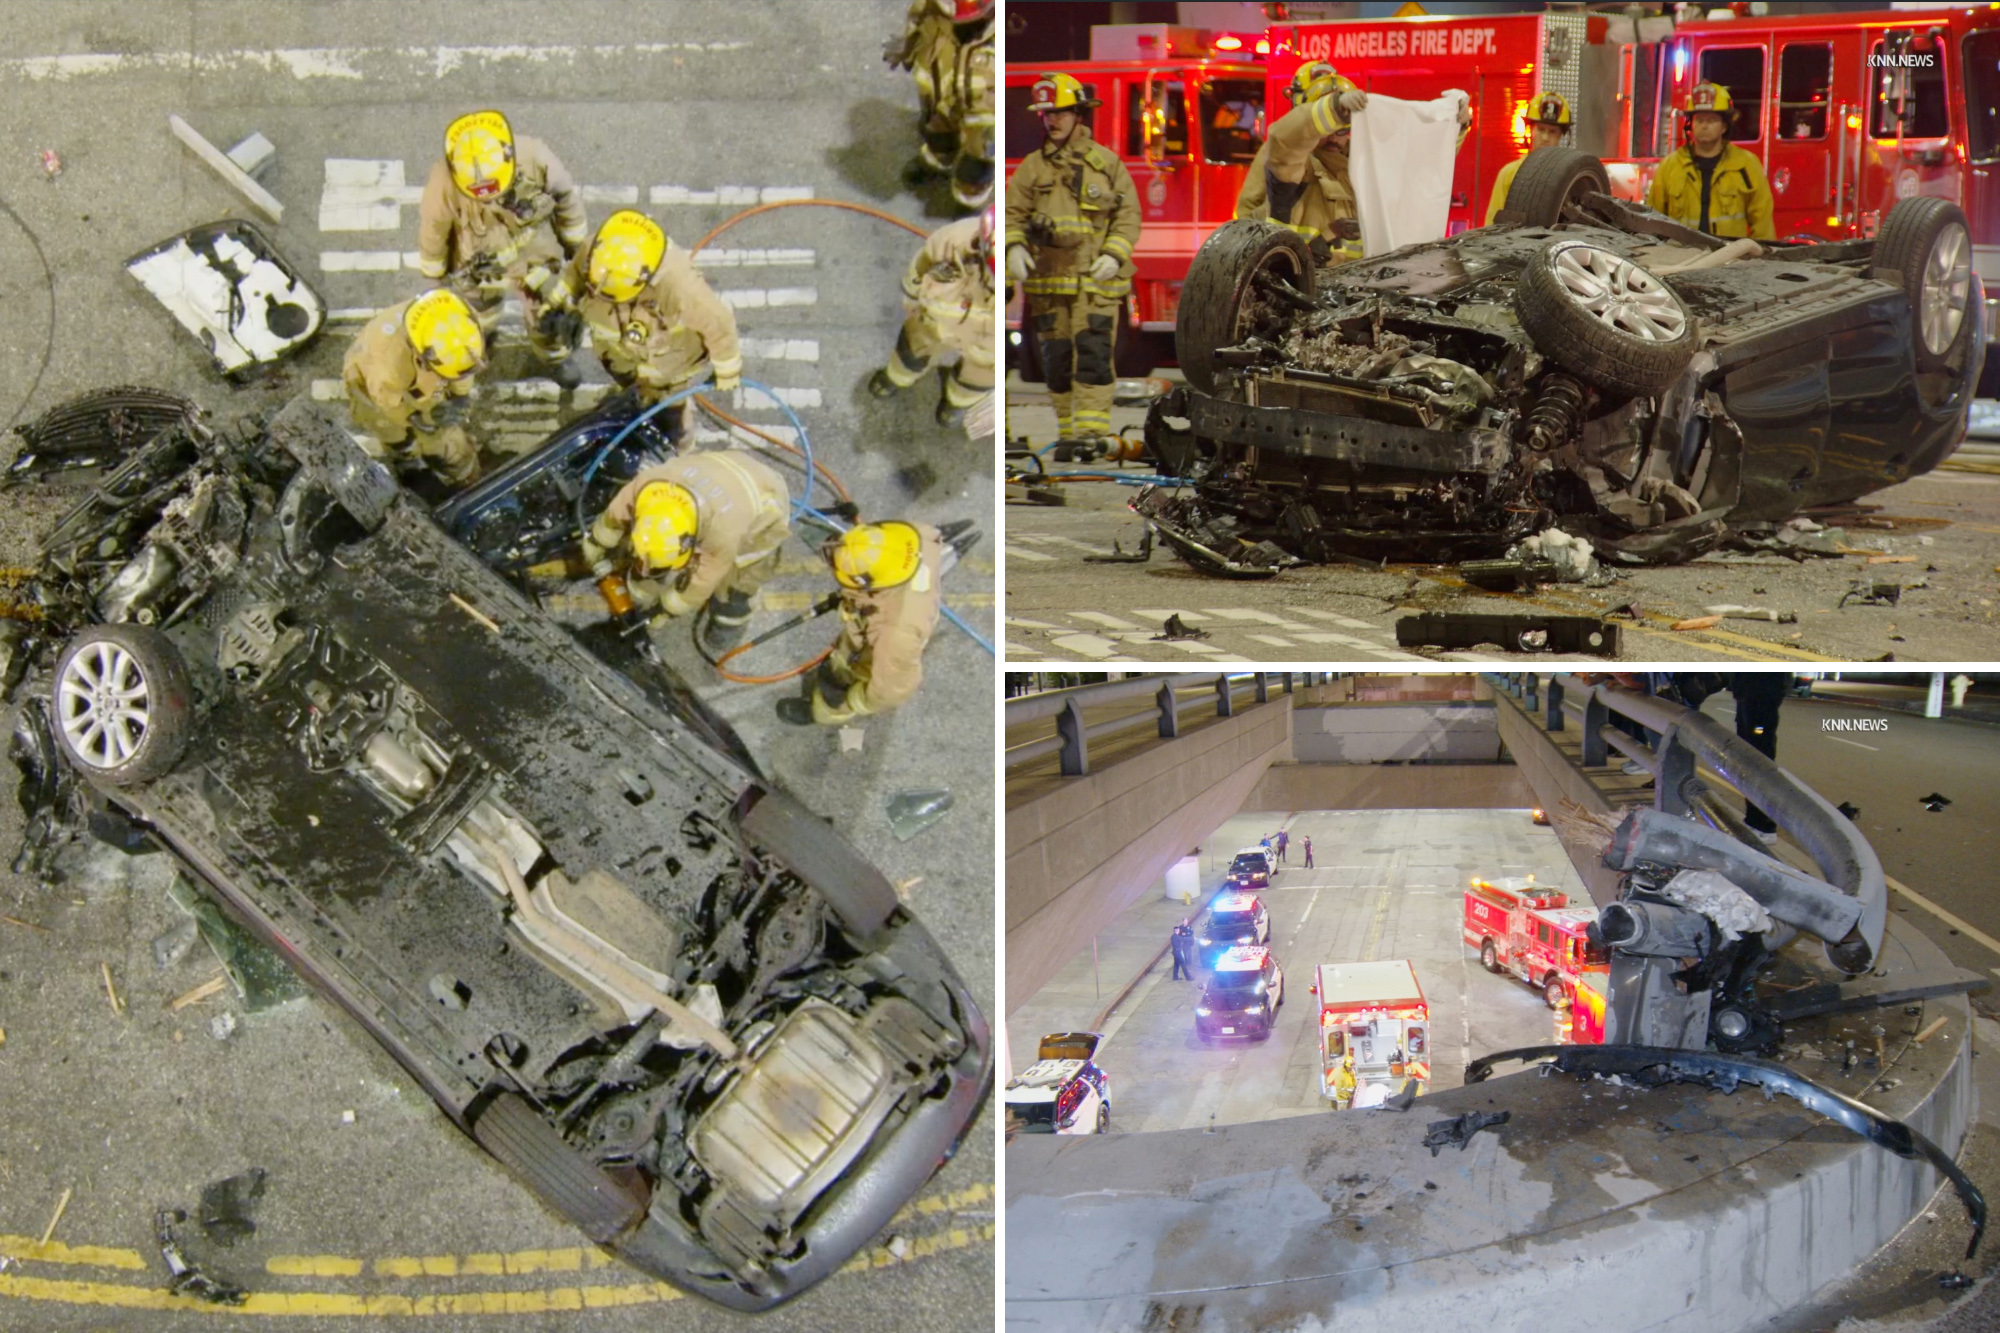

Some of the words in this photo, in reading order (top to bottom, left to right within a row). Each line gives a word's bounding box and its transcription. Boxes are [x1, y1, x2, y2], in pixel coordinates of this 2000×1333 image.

[1301, 36, 1331, 60] LOS
[1334, 31, 1408, 59] ANGELES
[1411, 29, 1447, 56] FIRE
[1451, 27, 1497, 55] DEPT.
[1474, 902, 1489, 919] 203
[1580, 1015, 1587, 1032] 3
